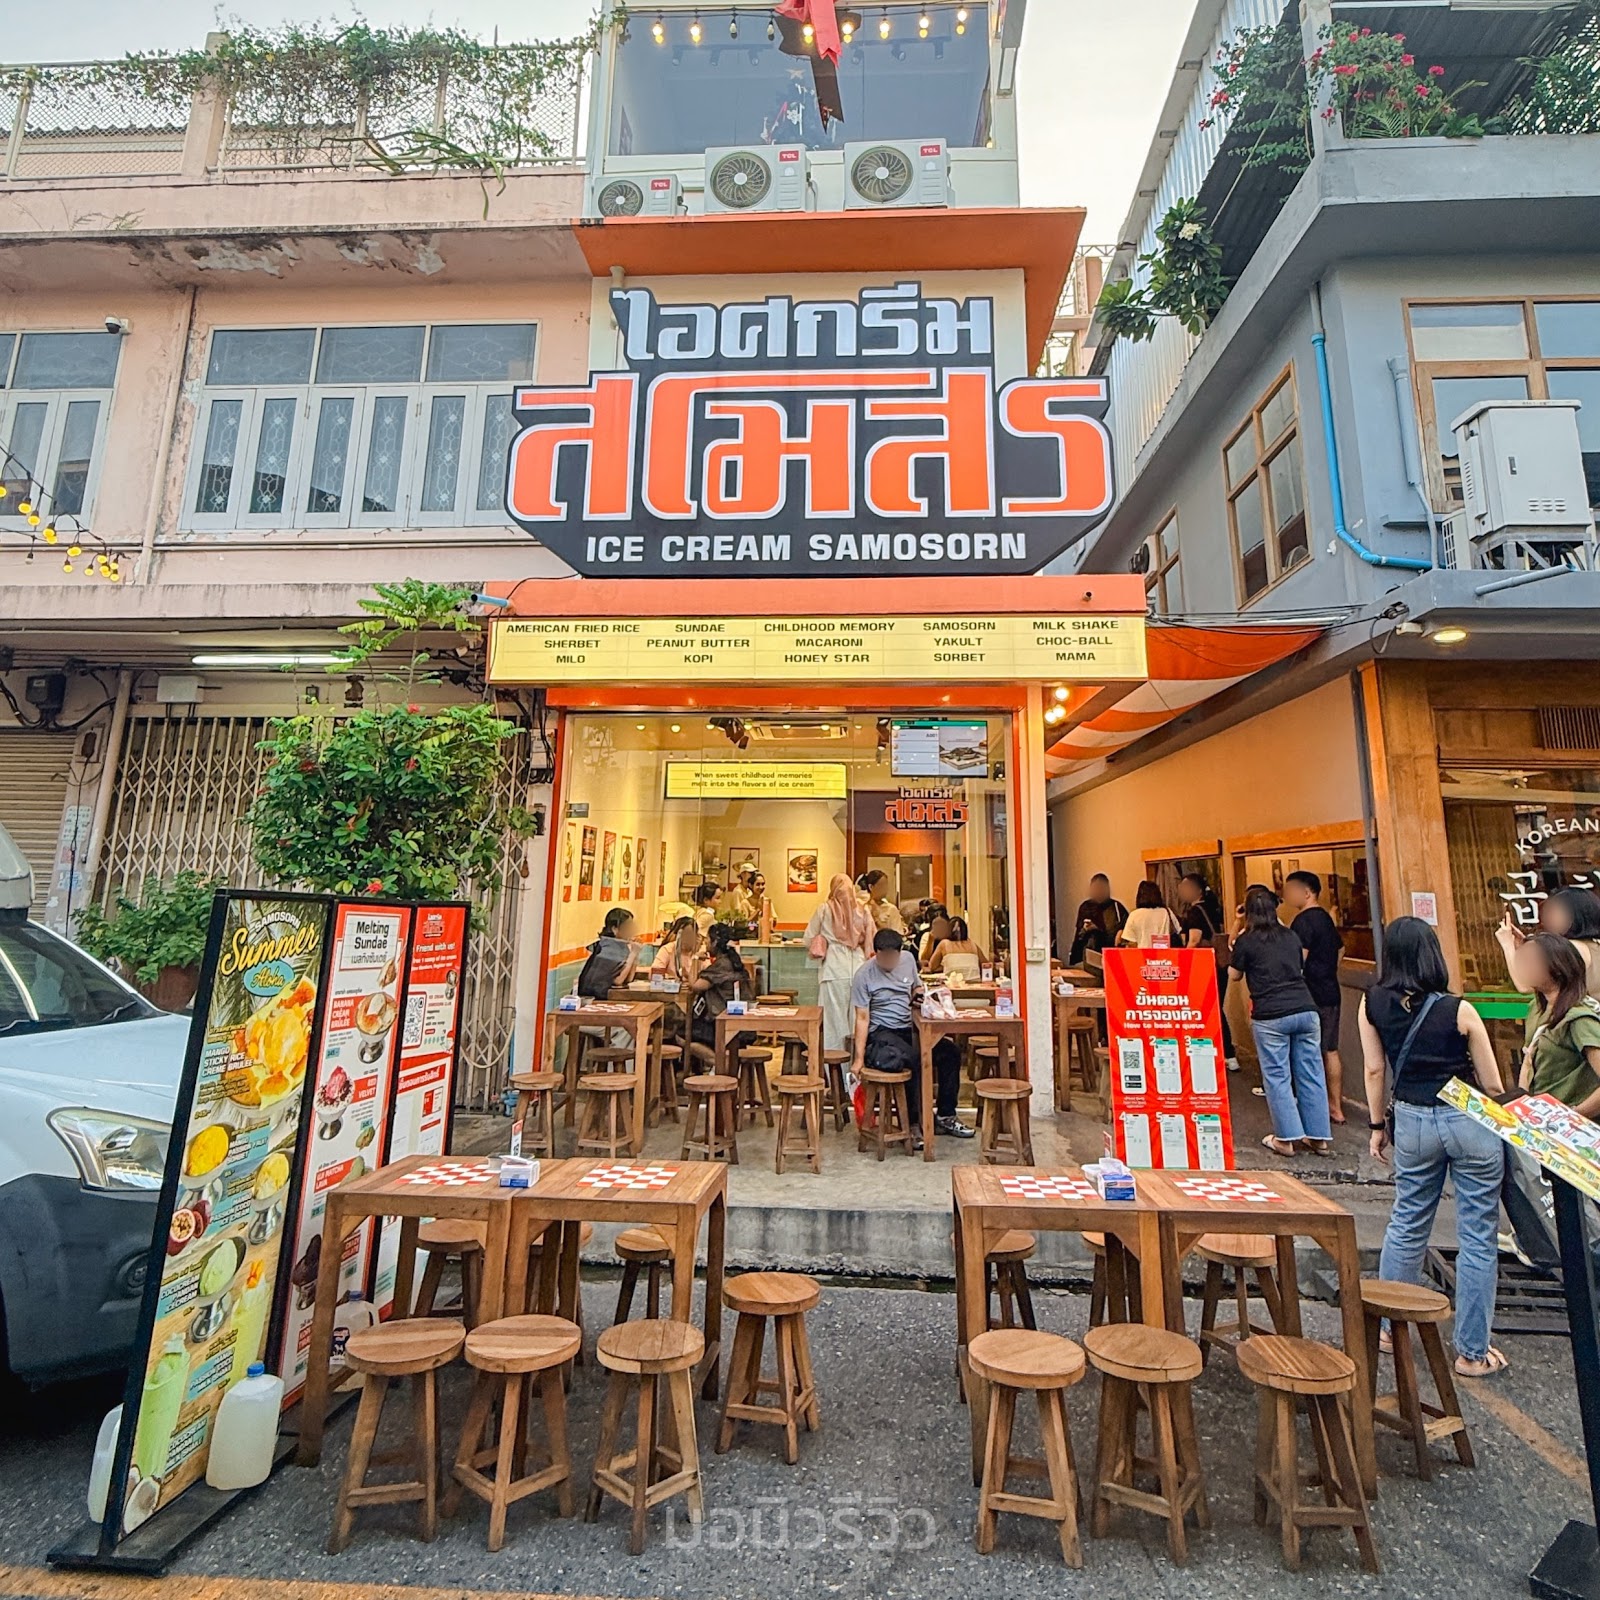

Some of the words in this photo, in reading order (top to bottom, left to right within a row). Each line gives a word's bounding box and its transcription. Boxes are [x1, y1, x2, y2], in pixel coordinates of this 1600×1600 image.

[612, 284, 991, 360] ไอศกรีม
[507, 367, 1112, 522] สโมสร
[586, 536, 644, 562] ICE
[661, 535, 791, 562] CREAM
[808, 533, 1026, 561] SAMOSORN
[506, 624, 570, 633] AMERICAN
[574, 624, 609, 633] FRIED
[613, 624, 640, 633] RICE
[675, 623, 725, 633] SUNDAE
[764, 623, 835, 632] CHILDHOOD
[840, 622, 895, 631] MEMORY
[923, 622, 996, 631] SAMOSORN
[1033, 621, 1066, 630] MILK
[1072, 620, 1119, 630] SHAKE
[544, 639, 601, 649] SHERBET
[647, 639, 696, 648] PEANUT
[701, 638, 750, 648] BUTTER
[795, 638, 863, 647] MACARONI
[934, 638, 983, 646] YAKULT
[1036, 636, 1113, 646] CHOC-BALL
[556, 655, 586, 664] MILO
[684, 654, 713, 664] KOPI
[785, 654, 828, 663] HONEY
[834, 654, 870, 662] STAR
[934, 653, 986, 662] SORBET
[1056, 652, 1096, 661] MAMA
[741, 771, 775, 779] childhood
[1514, 818, 1600, 855] KOREAN
[255, 911, 301, 932] SAMOSORN
[356, 920, 390, 938] Melting
[354, 935, 388, 950] Sundae
[220, 922, 320, 976] Summer
[251, 965, 285, 989] Aloha
[1135, 987, 1189, 1006] ขั้นตอน
[1125, 1007, 1202, 1021] การจองคิว
[1149, 1035, 1157, 1046] 2
[1184, 1035, 1192, 1046] 3
[205, 1047, 230, 1059] MANGO
[204, 1054, 229, 1068] STICKY
[229, 1052, 245, 1062] RICE
[358, 1087, 376, 1098] VELVET
[1119, 1111, 1127, 1121] 4
[1155, 1112, 1163, 1122] 5
[1191, 1112, 1198, 1122] 6
